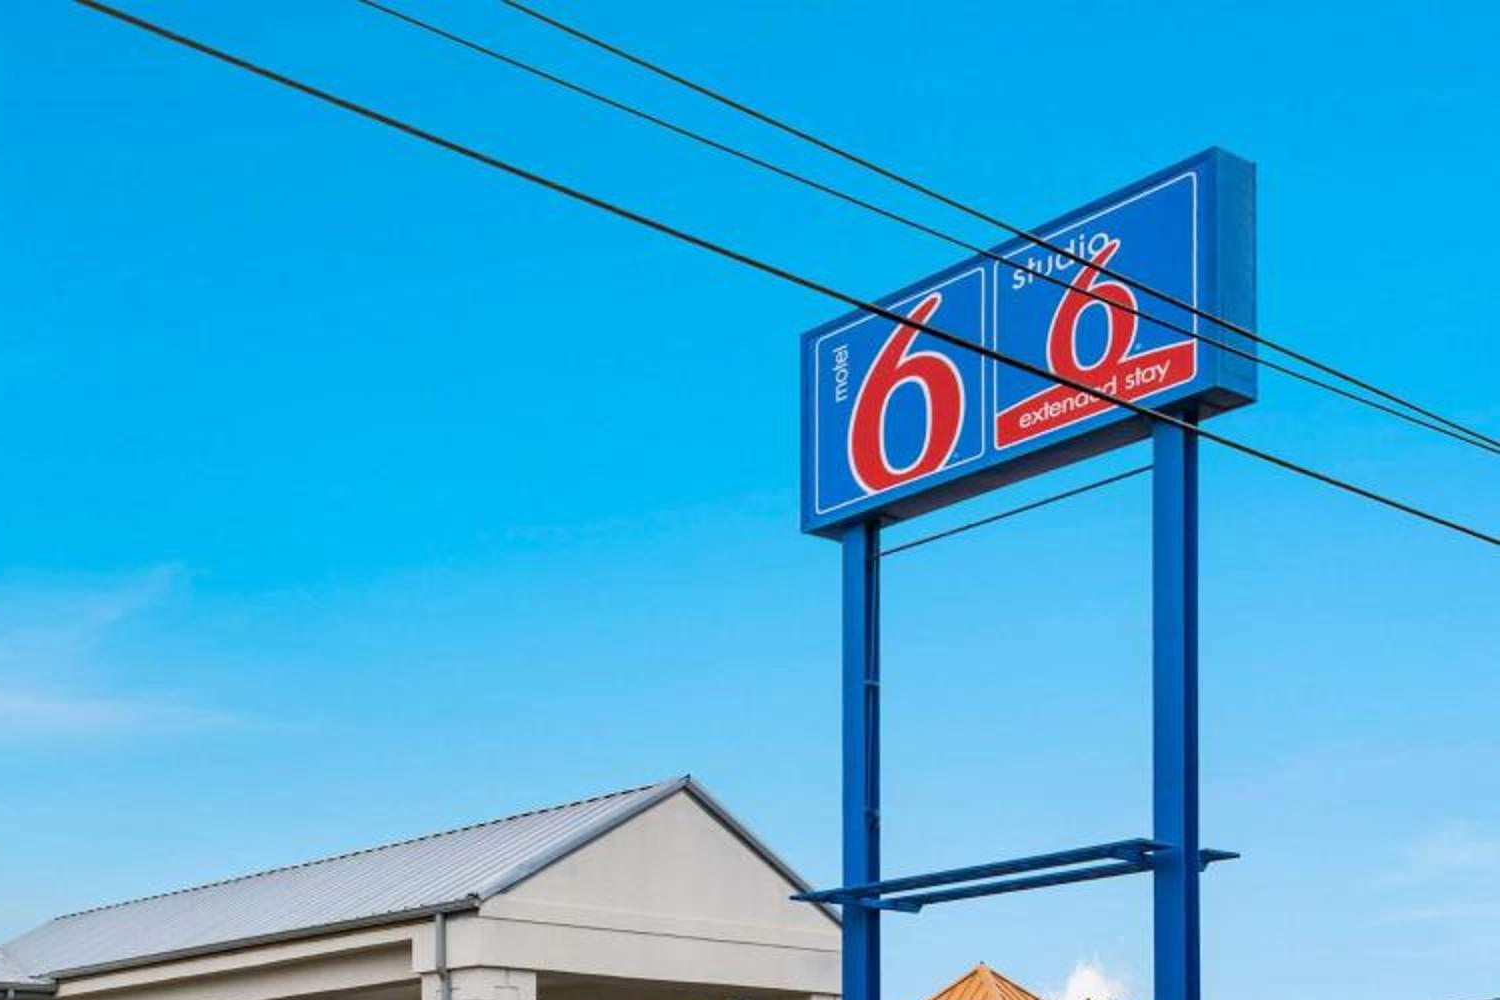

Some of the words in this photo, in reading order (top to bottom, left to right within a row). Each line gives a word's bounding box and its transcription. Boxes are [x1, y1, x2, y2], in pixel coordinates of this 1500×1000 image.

[1011, 232, 1111, 290] studio
[832, 345, 850, 403] motel
[847, 291, 966, 494] 6
[1124, 359, 1172, 391] stay
